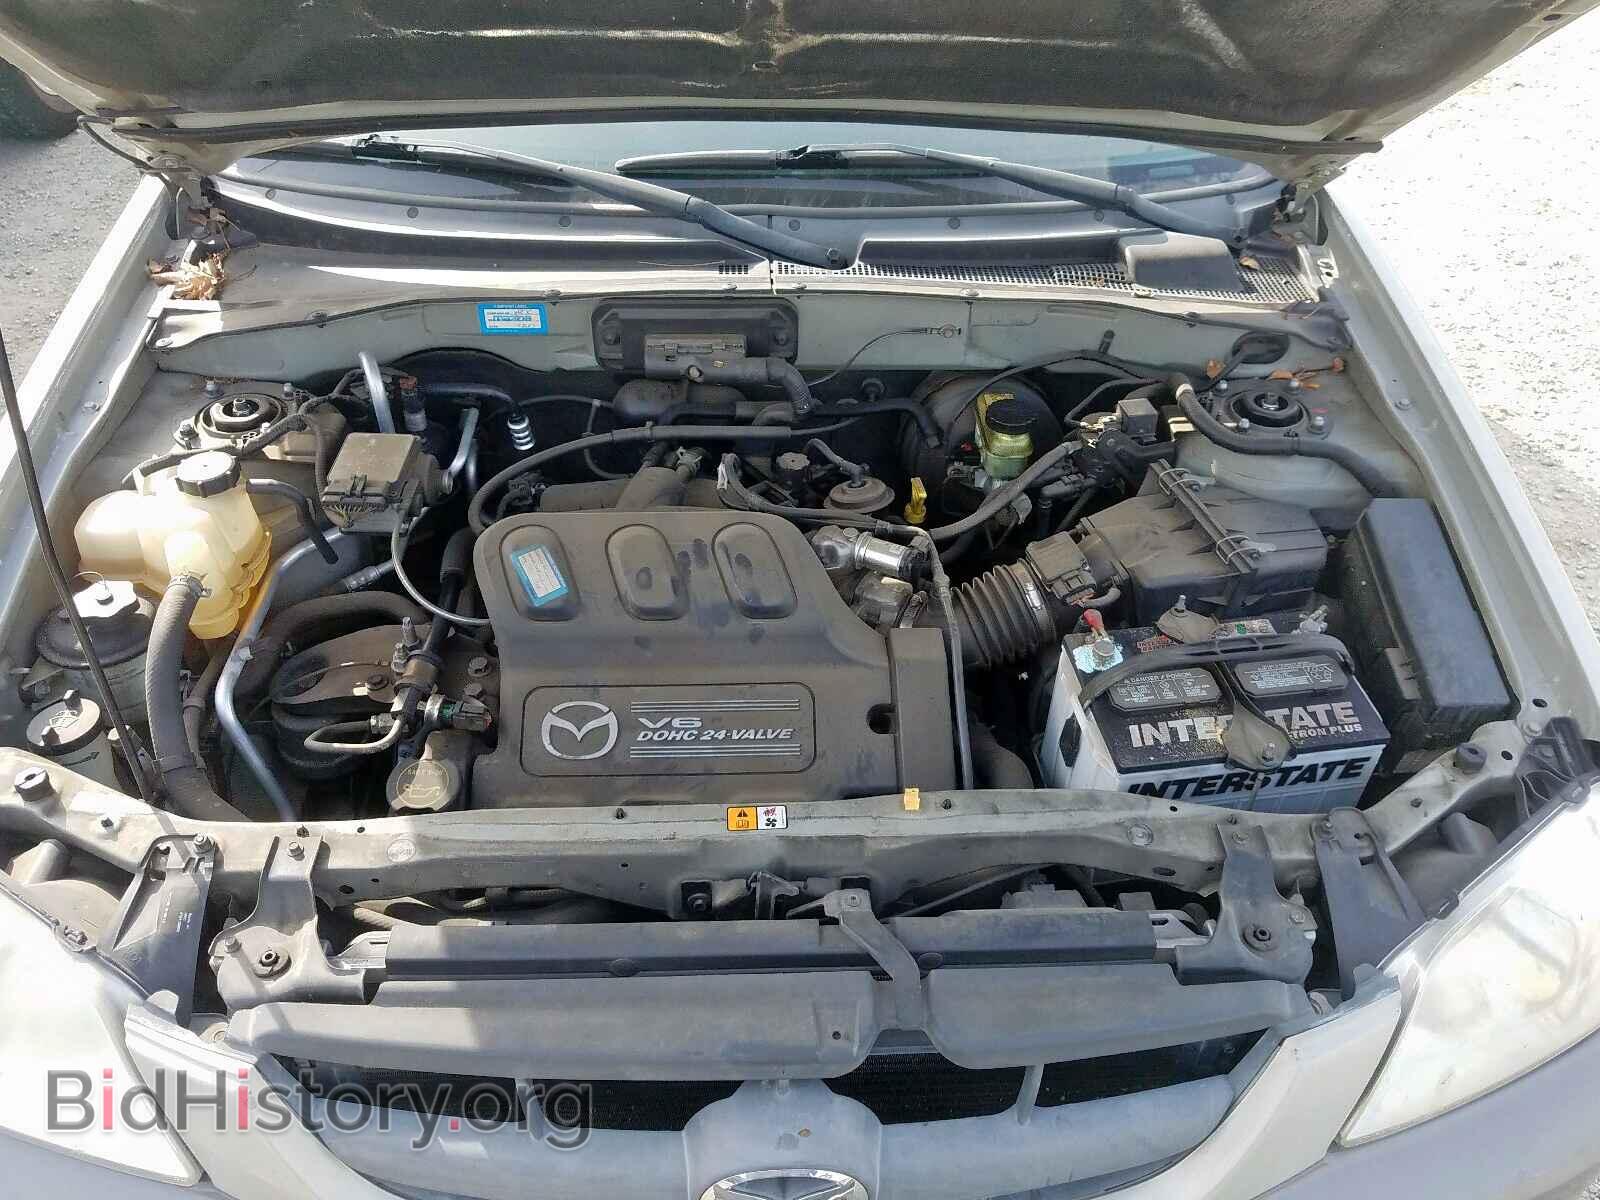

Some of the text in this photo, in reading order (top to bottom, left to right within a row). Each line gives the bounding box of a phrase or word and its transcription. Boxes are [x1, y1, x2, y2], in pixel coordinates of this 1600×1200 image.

[638, 717, 702, 729] V6
[1128, 701, 1360, 748] INTETATE
[1329, 723, 1362, 735] PLUS
[636, 728, 793, 741] DOHC 24-VALVE
